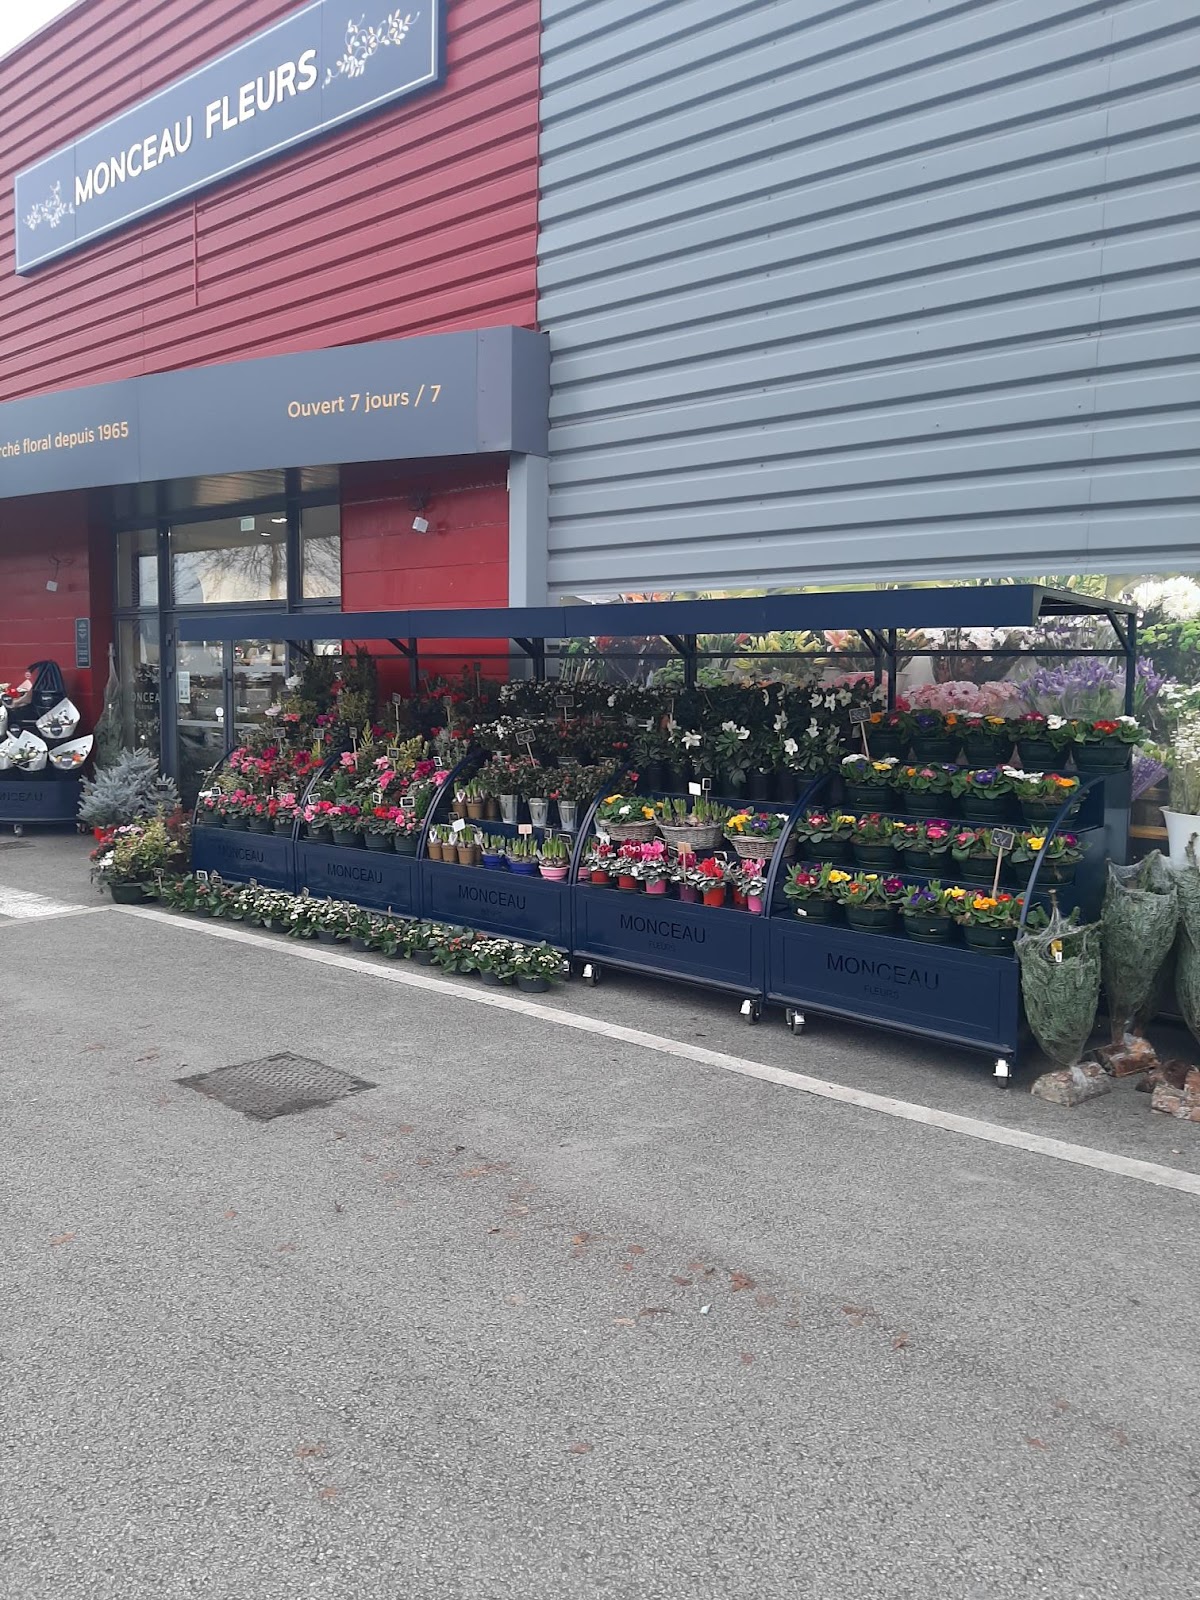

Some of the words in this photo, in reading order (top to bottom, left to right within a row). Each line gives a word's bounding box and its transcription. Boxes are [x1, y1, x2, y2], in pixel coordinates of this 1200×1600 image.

[75, 115, 193, 206] MONCEAU
[205, 49, 318, 139] FLEURS
[287, 396, 345, 418] Ouvert
[350, 393, 360, 411] 7
[365, 392, 410, 413] jours
[414, 384, 425, 407] /
[430, 385, 441, 403] 7
[23, 434, 51, 454] floral
[55, 427, 95, 449] depuis
[98, 421, 129, 441] 1965
[327, 863, 382, 884] MONCEAU
[458, 884, 526, 910] MONCEAU
[620, 914, 706, 943] MONCEAU
[827, 953, 939, 990] MONCEAU
